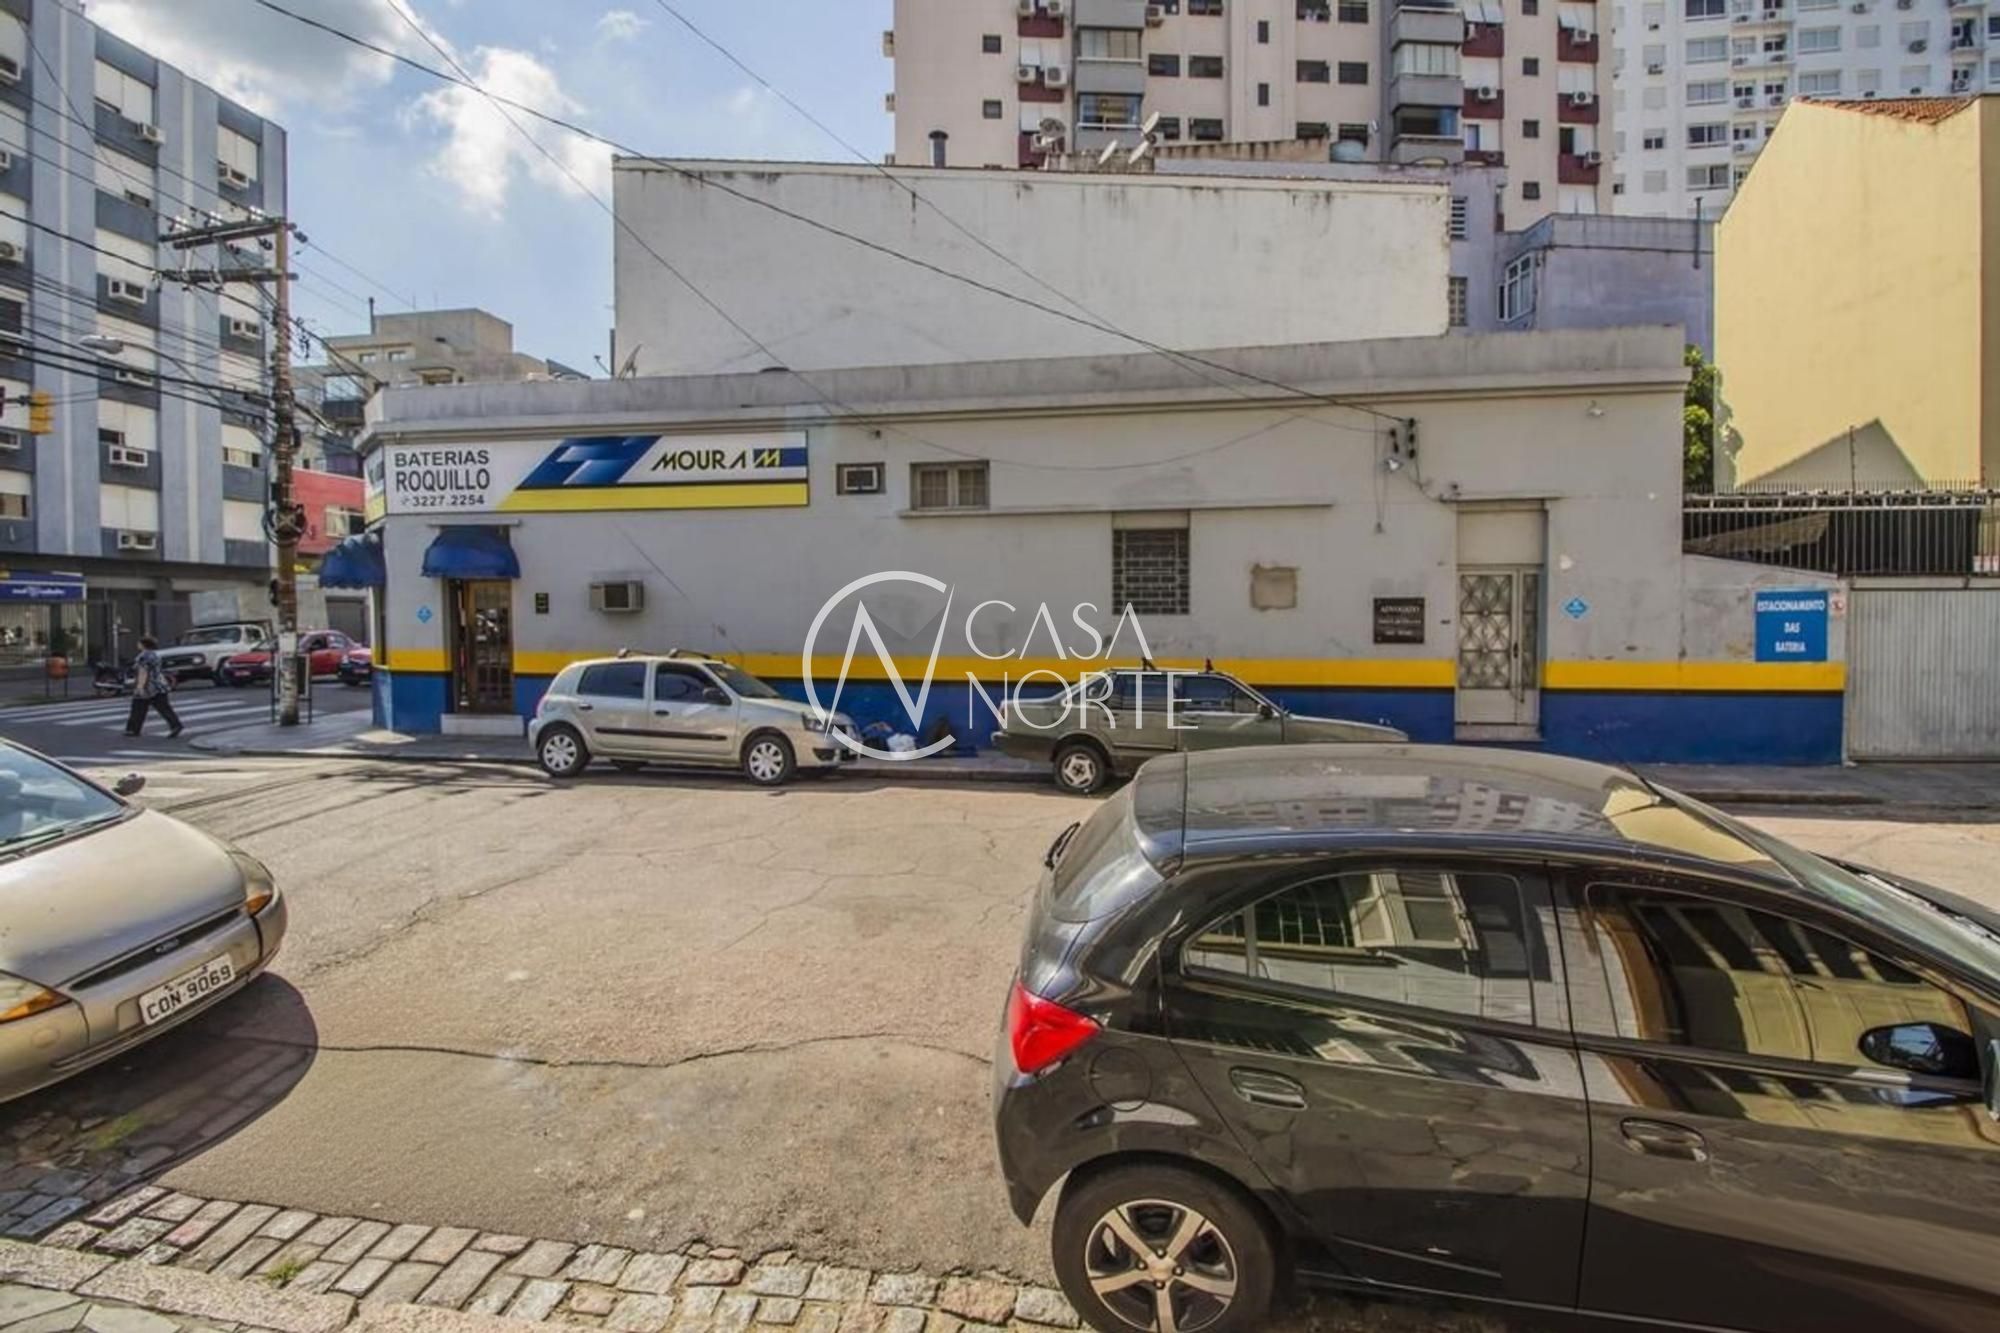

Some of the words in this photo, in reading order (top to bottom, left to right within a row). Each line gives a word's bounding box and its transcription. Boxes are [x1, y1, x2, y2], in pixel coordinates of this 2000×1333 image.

[394, 450, 490, 468] BATERIAS
[650, 450, 747, 472] MOURA
[395, 468, 490, 492] ROQUILLO
[1757, 600, 1825, 611] ESTACIONAMENTO
[1784, 621, 1801, 633] DAS
[1775, 641, 1806, 653] BATERIA
